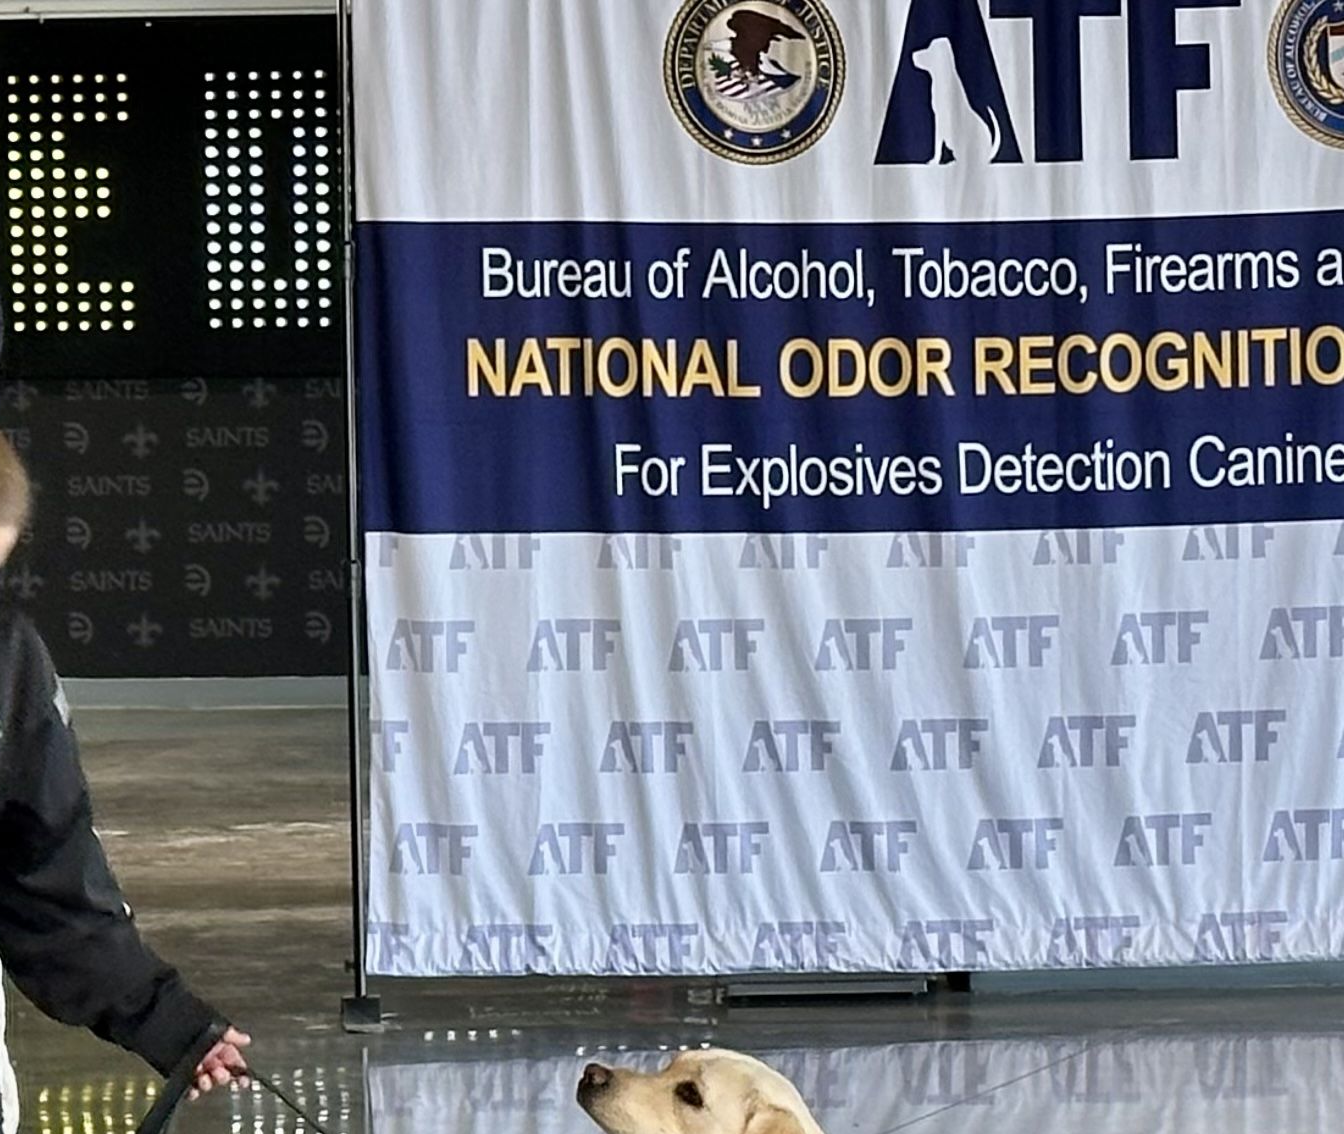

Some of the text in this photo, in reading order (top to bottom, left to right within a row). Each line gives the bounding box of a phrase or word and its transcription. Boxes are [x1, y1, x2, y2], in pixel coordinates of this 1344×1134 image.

[874, 0, 1242, 164] ATF
[481, 245, 632, 300] Bureau
[647, 246, 692, 300] of
[701, 246, 876, 308] Alcohol,
[892, 244, 1090, 304] Tobacco,
[1103, 241, 1302, 296] Firearms
[464, 335, 763, 399] NATIONAL
[776, 334, 957, 399] ODOR
[67, 380, 149, 401] SAINTS
[186, 426, 270, 448] SAINTS
[67, 475, 151, 497] SAINTS
[306, 474, 345, 495] SAI
[612, 443, 686, 497] For
[699, 443, 944, 511] Explosives
[955, 436, 1174, 496] Detection
[188, 522, 271, 544] SAINTS
[70, 570, 153, 592] SAINTS
[189, 618, 273, 639] SAINTS
[386, 621, 474, 672] ATF
[526, 619, 623, 672] ATF
[668, 619, 764, 672] ATF
[815, 618, 912, 671] ATF
[962, 615, 1059, 669] ATF
[1110, 610, 1208, 665] ATF
[454, 722, 551, 774] ATF
[599, 721, 694, 773] ATF
[742, 720, 840, 772] ATF
[890, 718, 988, 771] ATF
[1037, 714, 1136, 768] ATF
[1186, 709, 1286, 763] ATF
[388, 823, 478, 876] ATF
[528, 823, 625, 876] ATF
[674, 822, 769, 875] ATF
[820, 820, 916, 873] ATF
[967, 817, 1063, 870] ATF
[1114, 812, 1212, 867] ATF
